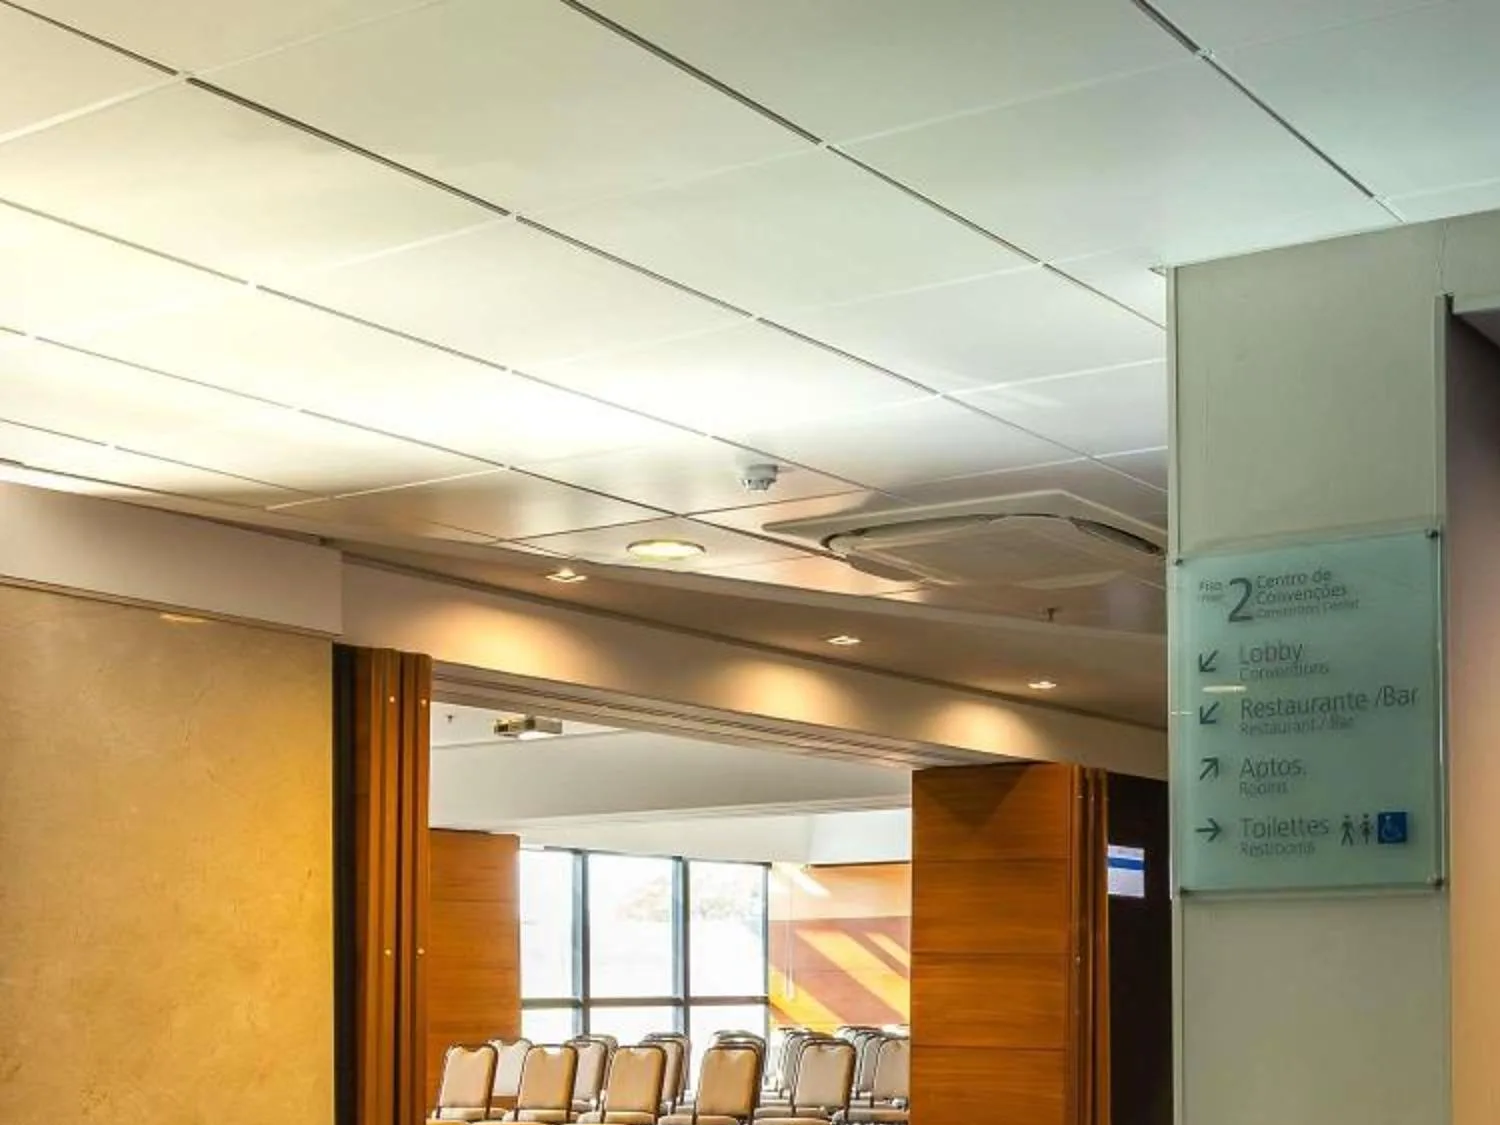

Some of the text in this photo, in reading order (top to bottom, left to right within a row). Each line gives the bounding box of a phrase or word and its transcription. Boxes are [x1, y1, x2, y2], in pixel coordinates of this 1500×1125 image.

[1256, 567, 1332, 589] Centro de
[1228, 576, 1253, 623] 2
[1256, 583, 1347, 605] Convenções
[1239, 640, 1303, 665] Lobby
[1240, 691, 1369, 720] Restaurante
[1240, 816, 1329, 839] Toilettes
